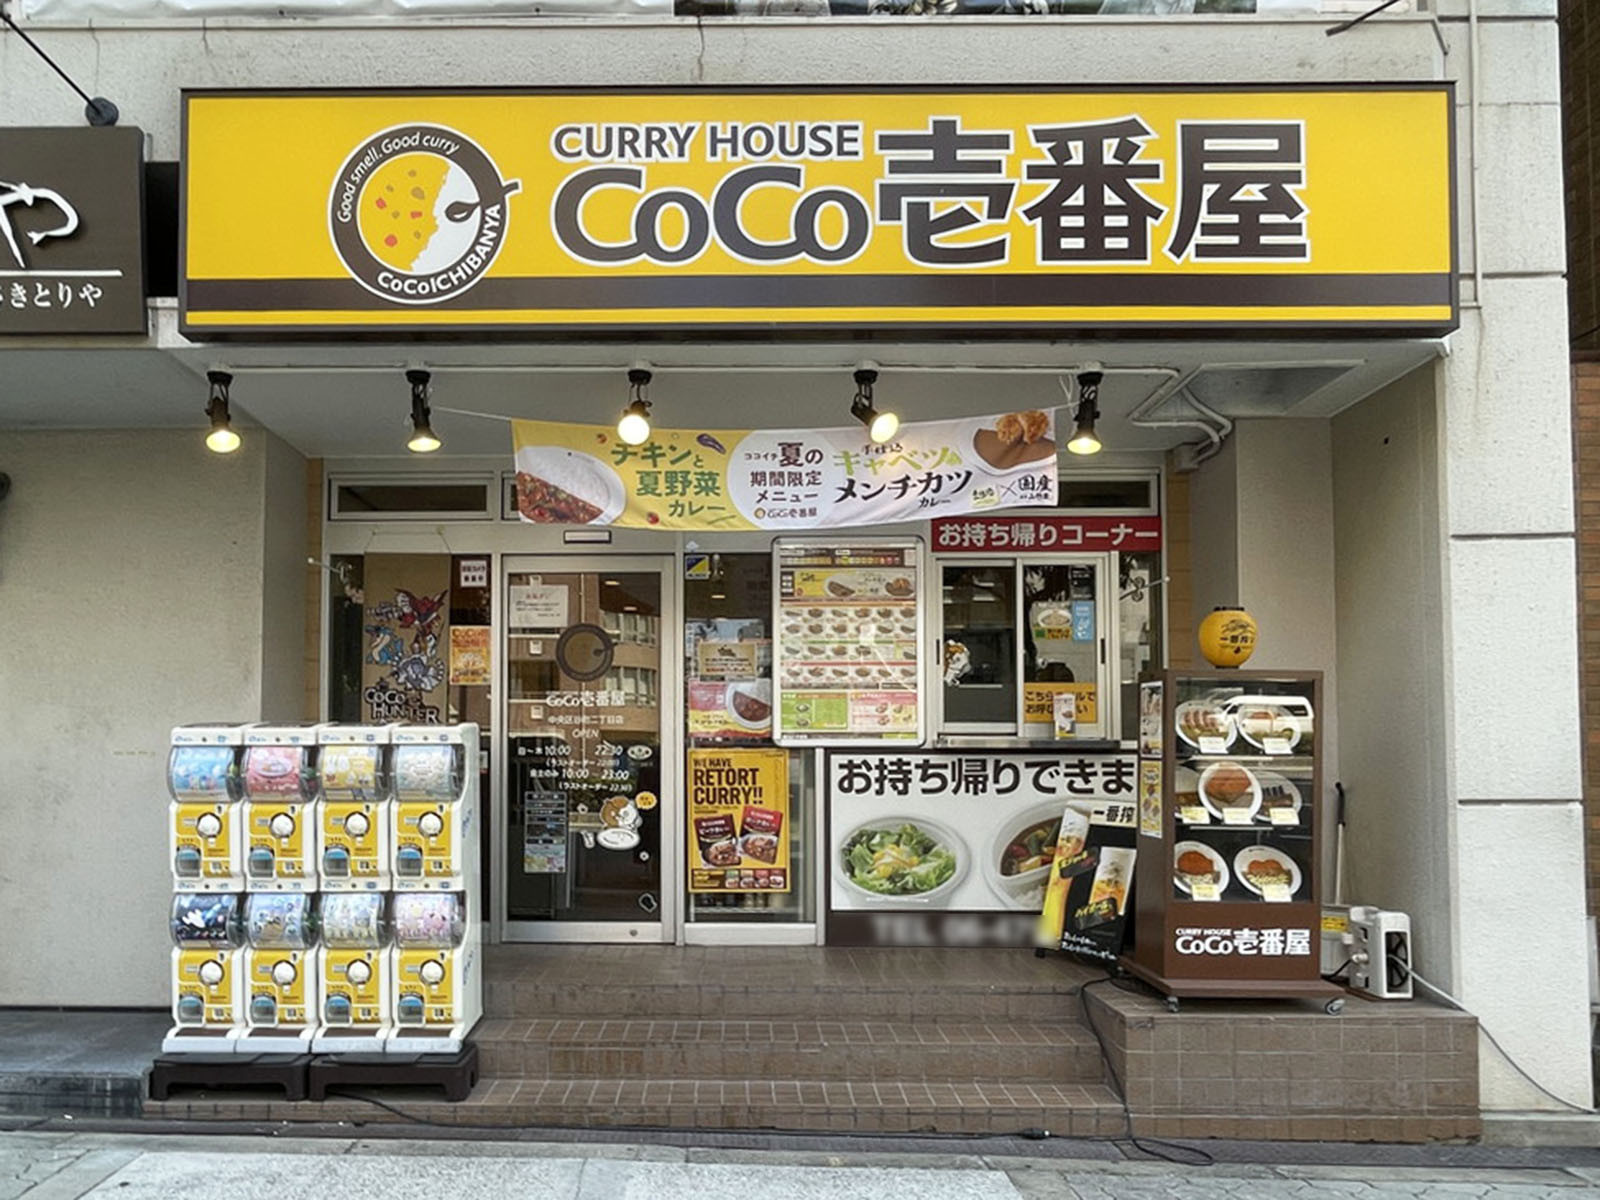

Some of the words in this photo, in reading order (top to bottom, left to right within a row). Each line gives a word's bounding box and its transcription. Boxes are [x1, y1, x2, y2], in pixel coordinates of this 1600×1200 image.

[552, 123, 699, 160] CURRY
[708, 122, 861, 159] HOUSE
[337, 180, 357, 223] Good
[380, 131, 422, 154] Good
[421, 134, 460, 155] curry
[0, 282, 103, 309] きとりや
[635, 469, 722, 498] 夏野菜
[749, 470, 823, 488] 期間限定
[833, 471, 974, 504] メンチカツ
[668, 499, 727, 518] カレー
[755, 489, 819, 504] メニュー
[918, 496, 952, 509] カレー
[938, 522, 1159, 548] お持ち帰りコーナー
[693, 768, 760, 786] RETORT
[837, 757, 1136, 796] お持ち帰りできま
[693, 787, 764, 806] CURRY!!
[1175, 928, 1311, 956] CoCo壱番屋
